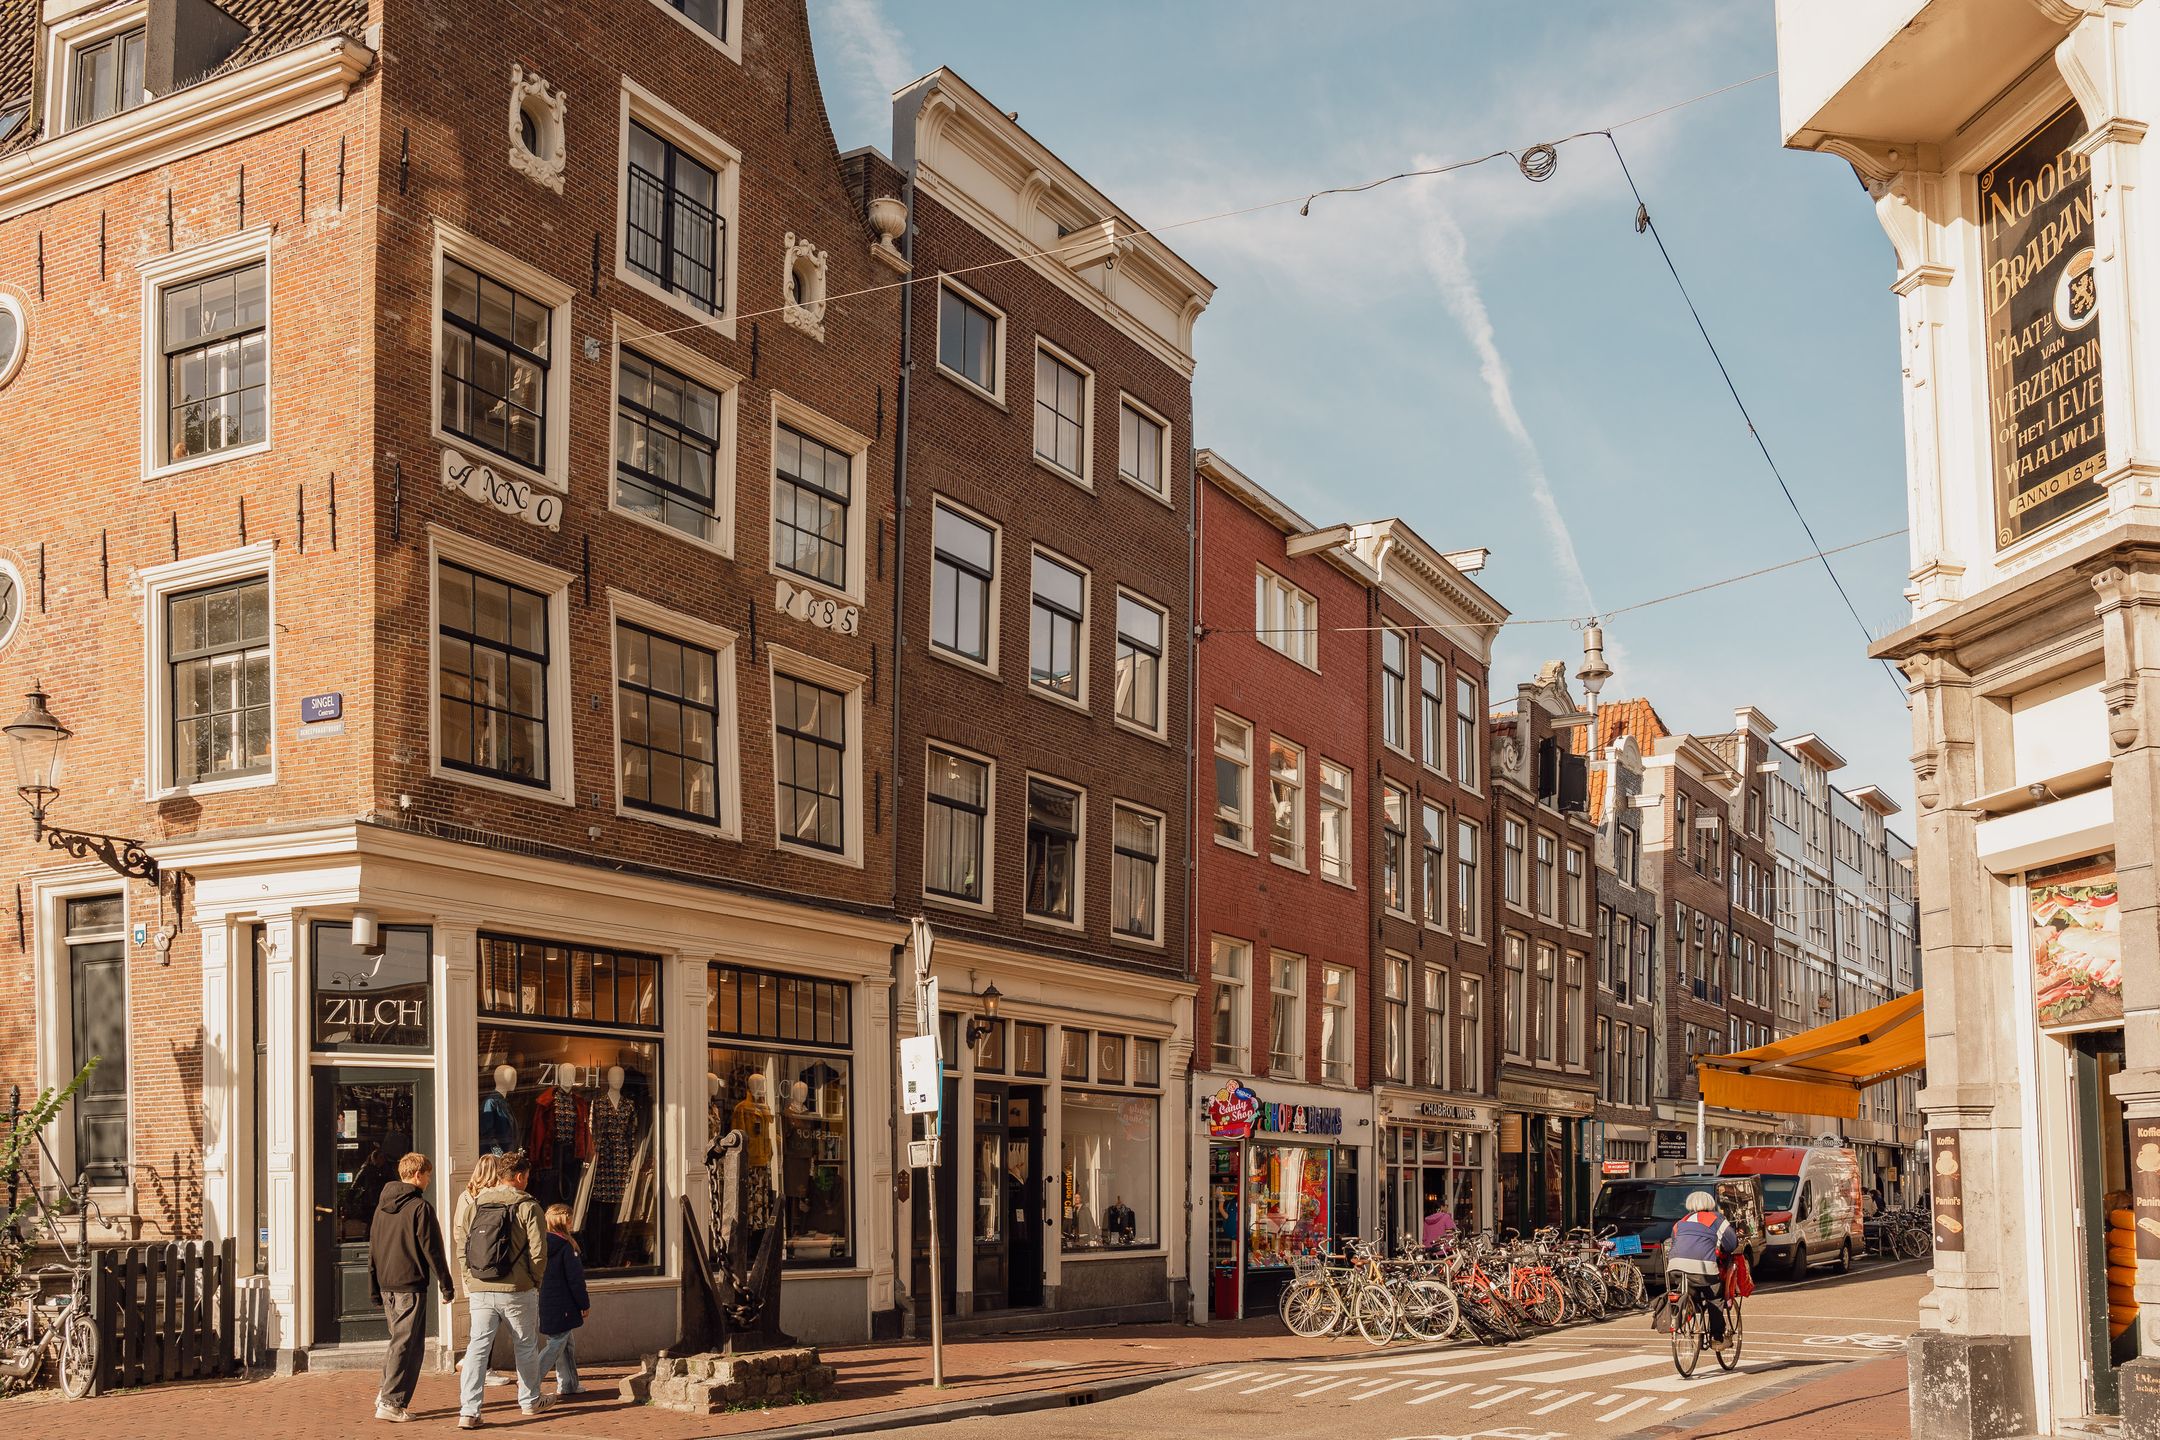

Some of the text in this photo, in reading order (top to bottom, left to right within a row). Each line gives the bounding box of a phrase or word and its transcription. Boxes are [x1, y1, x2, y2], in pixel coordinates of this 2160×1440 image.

[2041, 336, 2065, 360] VAN
[2000, 423, 2019, 443] OP
[2018, 419, 2046, 448] HET
[2016, 453, 2107, 513] ANNO 1843
[448, 465, 553, 523] ANNO
[786, 592, 856, 632] 1685
[311, 695, 335, 709] SINGEL
[324, 998, 423, 1026] ZILCH
[1219, 1100, 1247, 1115] Candy
[1232, 1109, 1253, 1122] Shop
[1423, 1103, 1476, 1120] CHABROL WINES
[1264, 1102, 1342, 1135] SHOP DRINKS
[1936, 1137, 1955, 1145] Koffie
[1199, 1196, 1204, 1206] 5
[1935, 1197, 1961, 1206] Panini's
